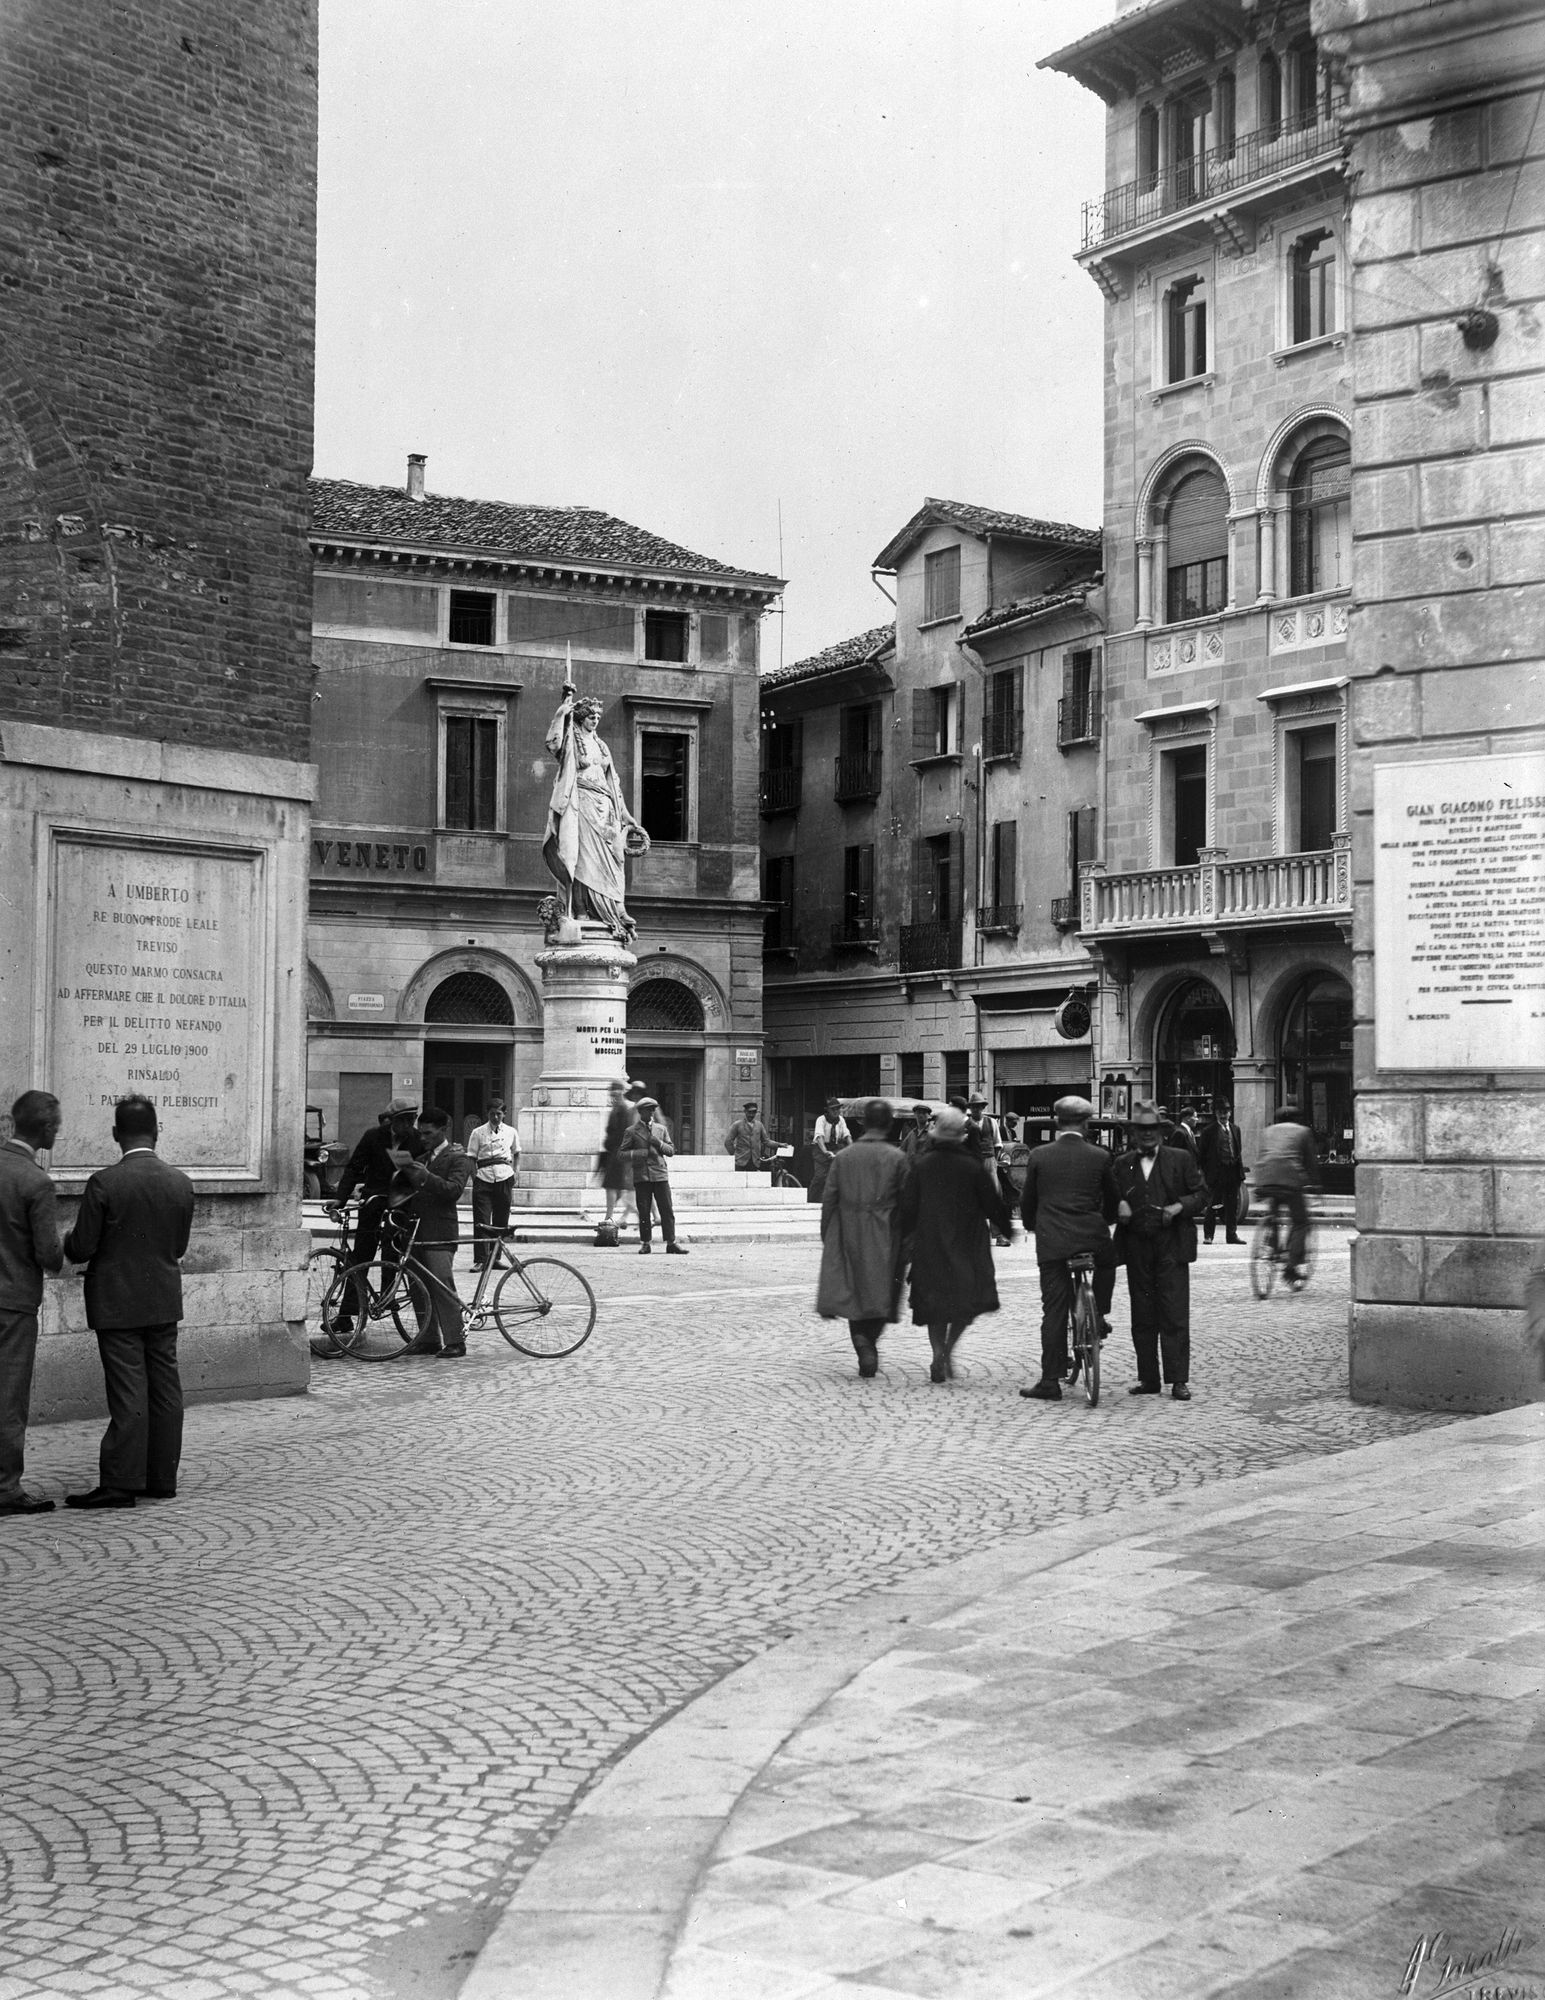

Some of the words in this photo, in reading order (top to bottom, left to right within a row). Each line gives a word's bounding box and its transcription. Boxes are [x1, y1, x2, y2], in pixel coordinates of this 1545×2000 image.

[1441, 800, 1494, 814] GIACOMO
[314, 840, 427, 871] VENETO
[108, 883, 116, 898] A
[127, 884, 189, 902] UMBERTO
[94, 910, 107, 922] RE
[113, 912, 146, 925] BUONO
[151, 916, 182, 928] PRODE
[187, 918, 219, 930] LEALE
[136, 940, 177, 953] TREVISO
[86, 963, 127, 977] QUESTO
[132, 966, 168, 978] MARMO
[173, 968, 223, 981] CONSACRA
[58, 988, 70, 998] AD
[74, 988, 131, 1002] AFFERMARE
[136, 992, 153, 1003] CHE
[158, 993, 165, 1004] IL
[170, 994, 205, 1005] DOLORE
[209, 995, 246, 1008] D'ITALIA
[84, 1016, 103, 1027] PER
[110, 1017, 118, 1027] IL
[125, 1017, 170, 1029] DELITTO
[176, 1020, 222, 1032] NEFANDO
[98, 1042, 118, 1053] DEL
[125, 1043, 137, 1054] 29
[142, 1044, 181, 1056] LUGLIO
[185, 1045, 208, 1056] 1900
[163, 1095, 218, 1108] PLEBISCITI
